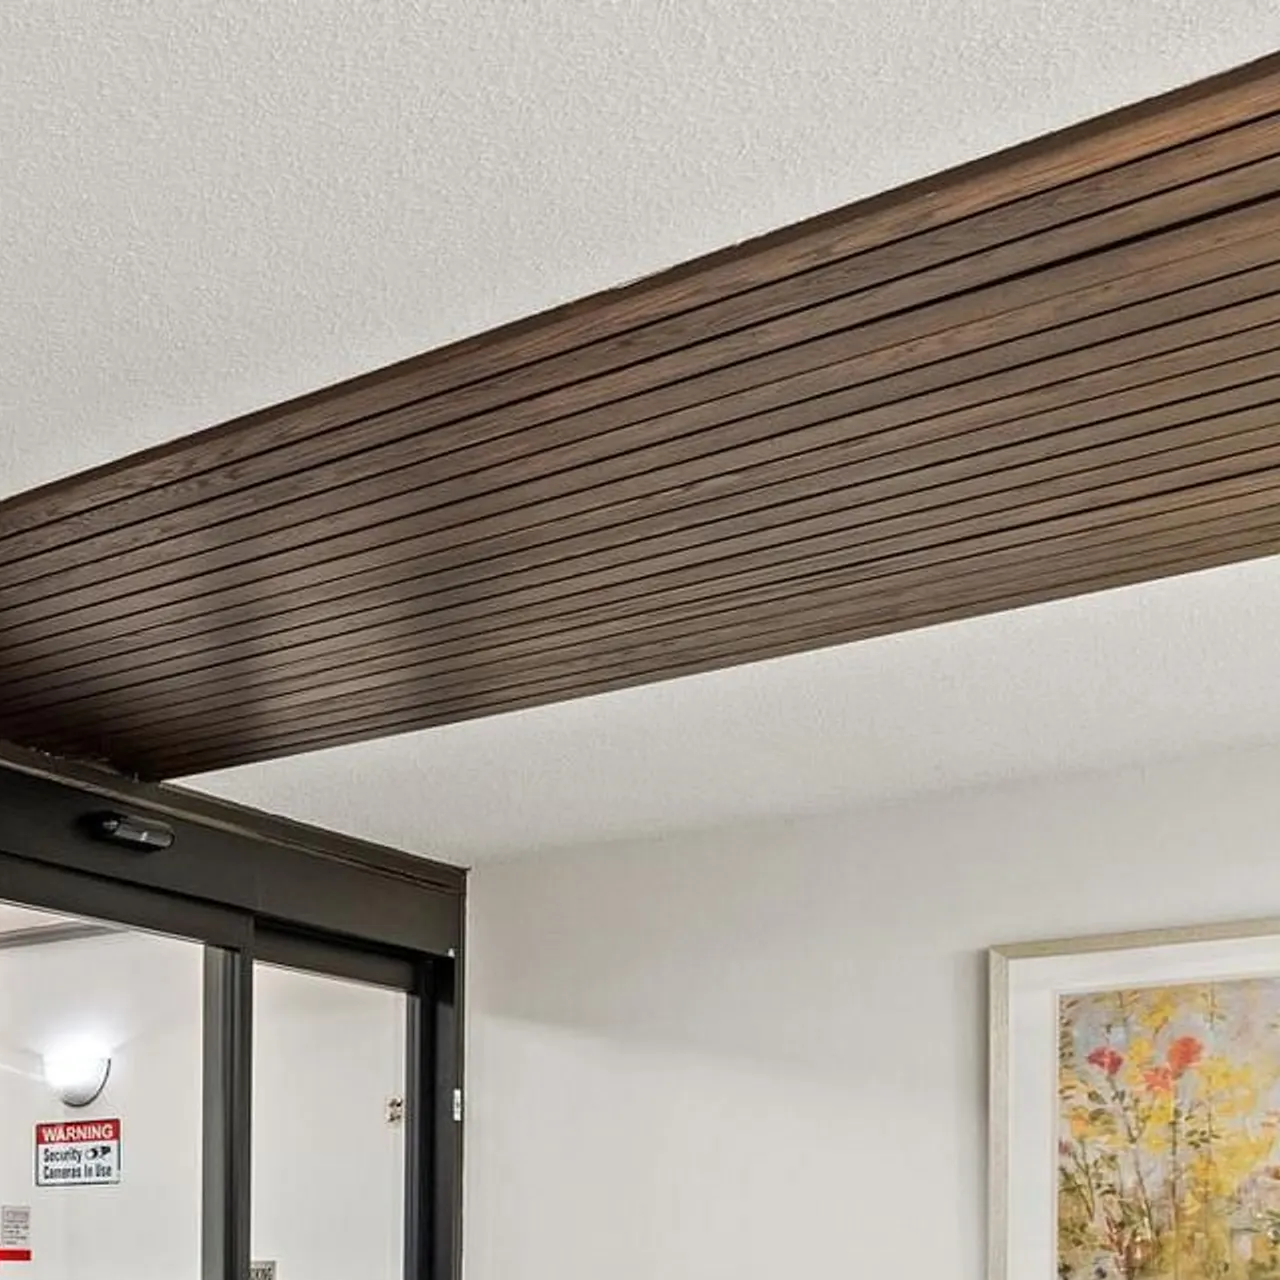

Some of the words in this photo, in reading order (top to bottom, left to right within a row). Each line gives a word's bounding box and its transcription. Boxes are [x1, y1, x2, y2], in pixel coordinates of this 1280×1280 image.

[42, 1124, 114, 1142] WARNING
[43, 1147, 81, 1163] Security
[43, 1165, 81, 1180] Cameras
[84, 1164, 93, 1178] In
[95, 1164, 112, 1177] Use
